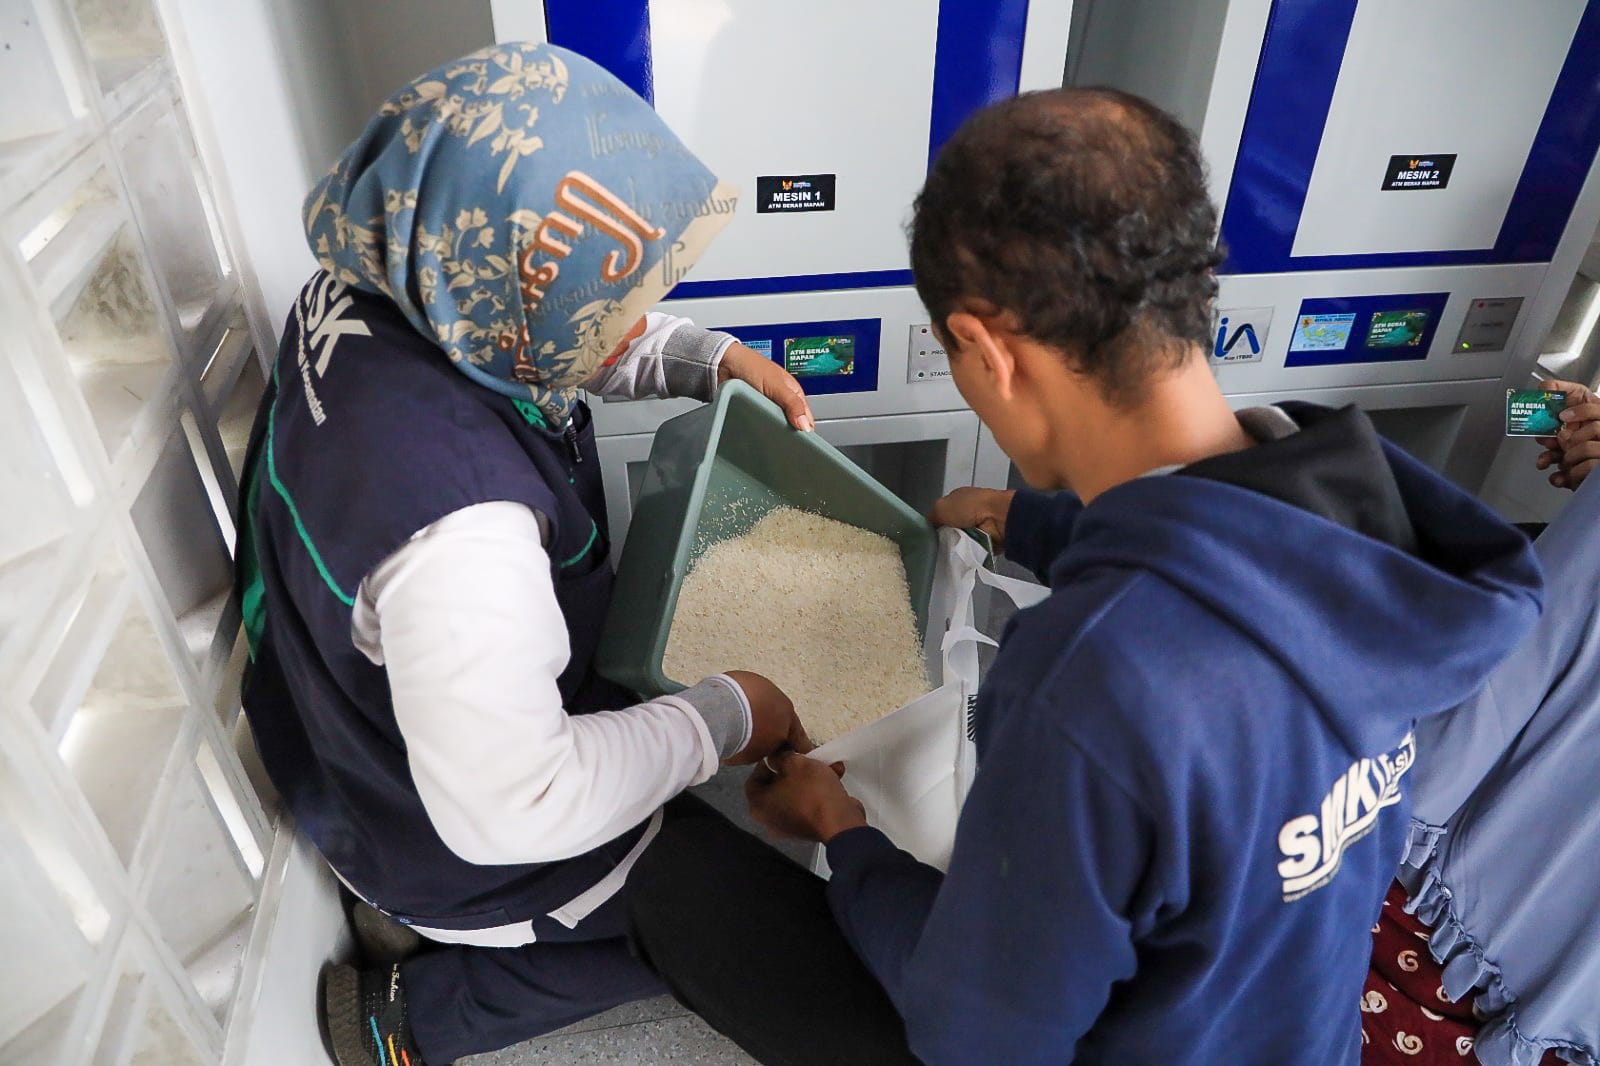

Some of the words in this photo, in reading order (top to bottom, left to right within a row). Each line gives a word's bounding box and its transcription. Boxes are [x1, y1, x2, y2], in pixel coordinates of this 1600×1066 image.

[1396, 170, 1431, 180] MESIN
[1431, 170, 1440, 179] 2
[773, 191, 811, 202] MESIN
[814, 191, 821, 201] 1
[1511, 408, 1533, 416] MAPAN
[1277, 757, 1379, 879] SMK
